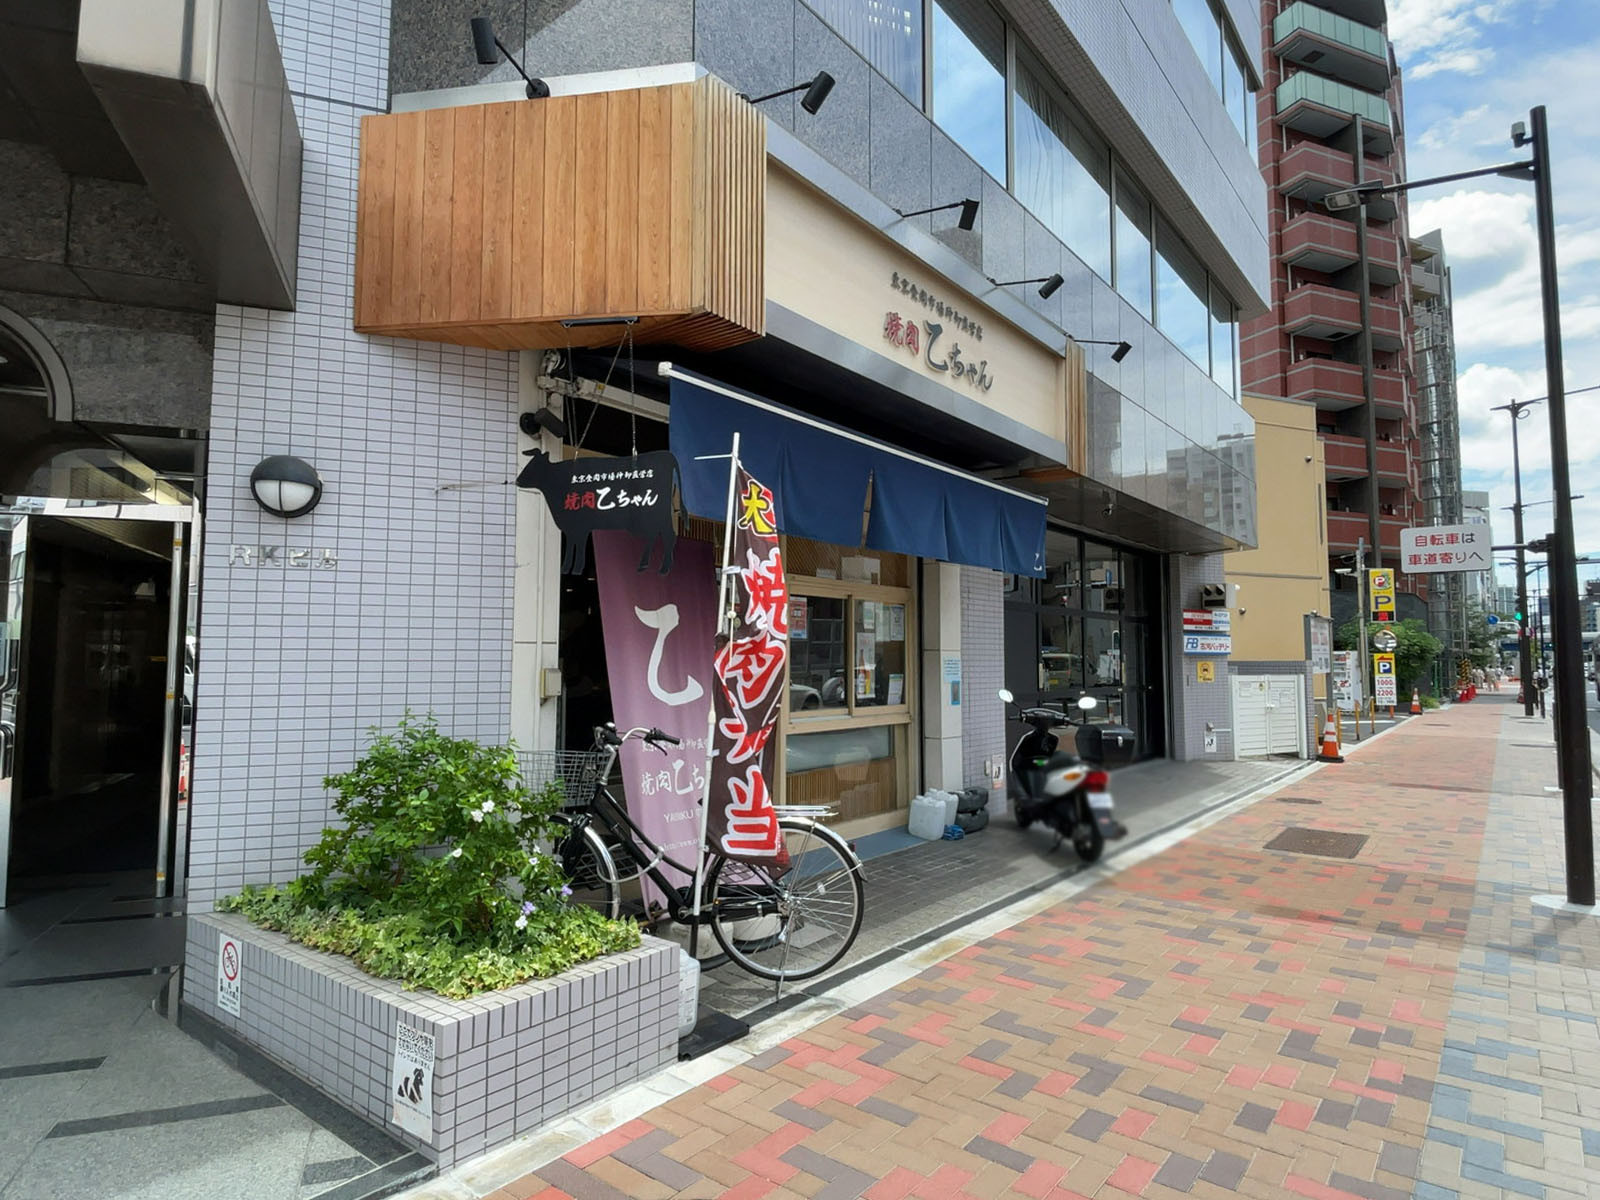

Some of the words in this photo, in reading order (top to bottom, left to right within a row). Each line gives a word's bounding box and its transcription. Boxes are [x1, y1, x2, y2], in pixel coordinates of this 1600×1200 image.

[883, 311, 994, 392] 焼肉乙ちゃん
[563, 486, 659, 511] 焼肉乙ちゃん
[1415, 532, 1475, 547] 自転車は
[1407, 551, 1485, 566] 車道寄りへ
[1375, 596, 1391, 609] P
[634, 603, 704, 706] 乙
[1380, 662, 1391, 673] P
